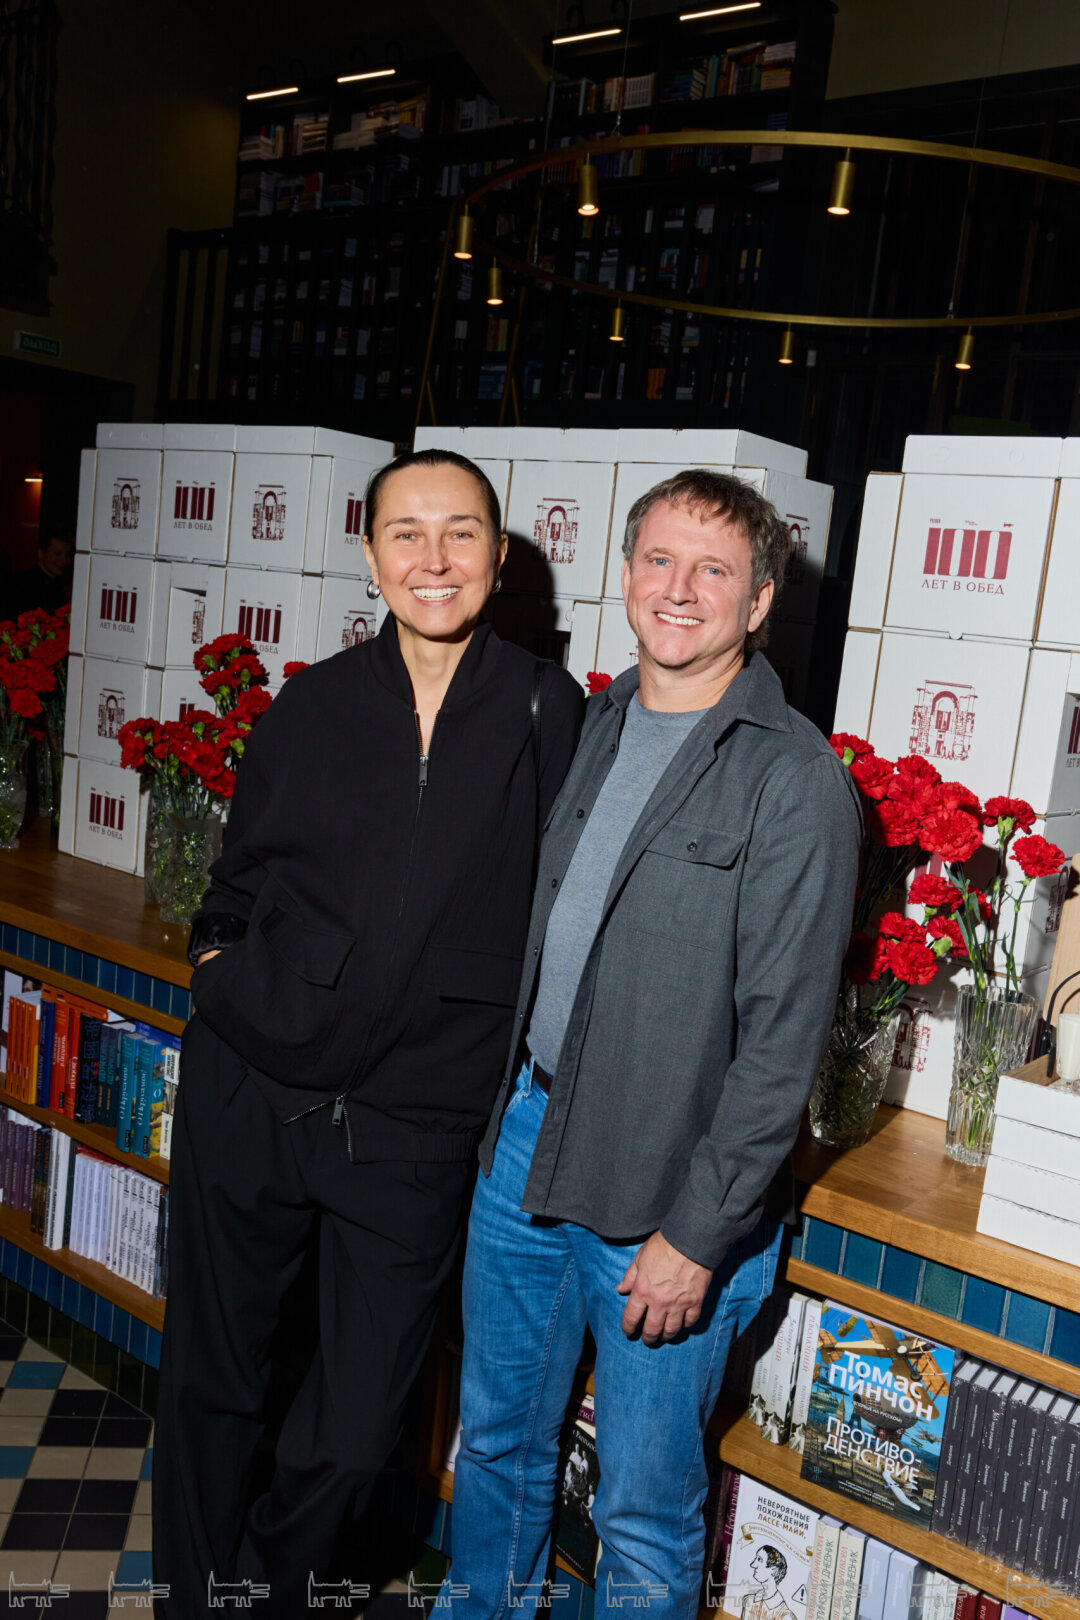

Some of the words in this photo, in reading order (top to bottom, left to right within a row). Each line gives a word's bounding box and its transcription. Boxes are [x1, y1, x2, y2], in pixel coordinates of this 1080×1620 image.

[344, 536, 360, 545] ЛЕТ
[923, 527, 1013, 580] 100
[921, 579, 948, 590] ЛЕТ
[953, 580, 961, 591] В
[966, 581, 1005, 595] ОБЕД
[829, 1364, 933, 1421] Пинчон
[844, 1351, 924, 1399] Томас
[826, 1416, 922, 1465] ПРОТИВО-
[757, 1496, 810, 1523] НЕВЕРОЯТНЫЕ
[757, 1504, 809, 1531] ПОХОЖДЕНИЯ
[757, 1514, 806, 1539] ЛАССЕ-МАЙИ,
[821, 1539, 834, 1579] ДНЕВНИК
[847, 1550, 858, 1589] ДНЕВНИК
